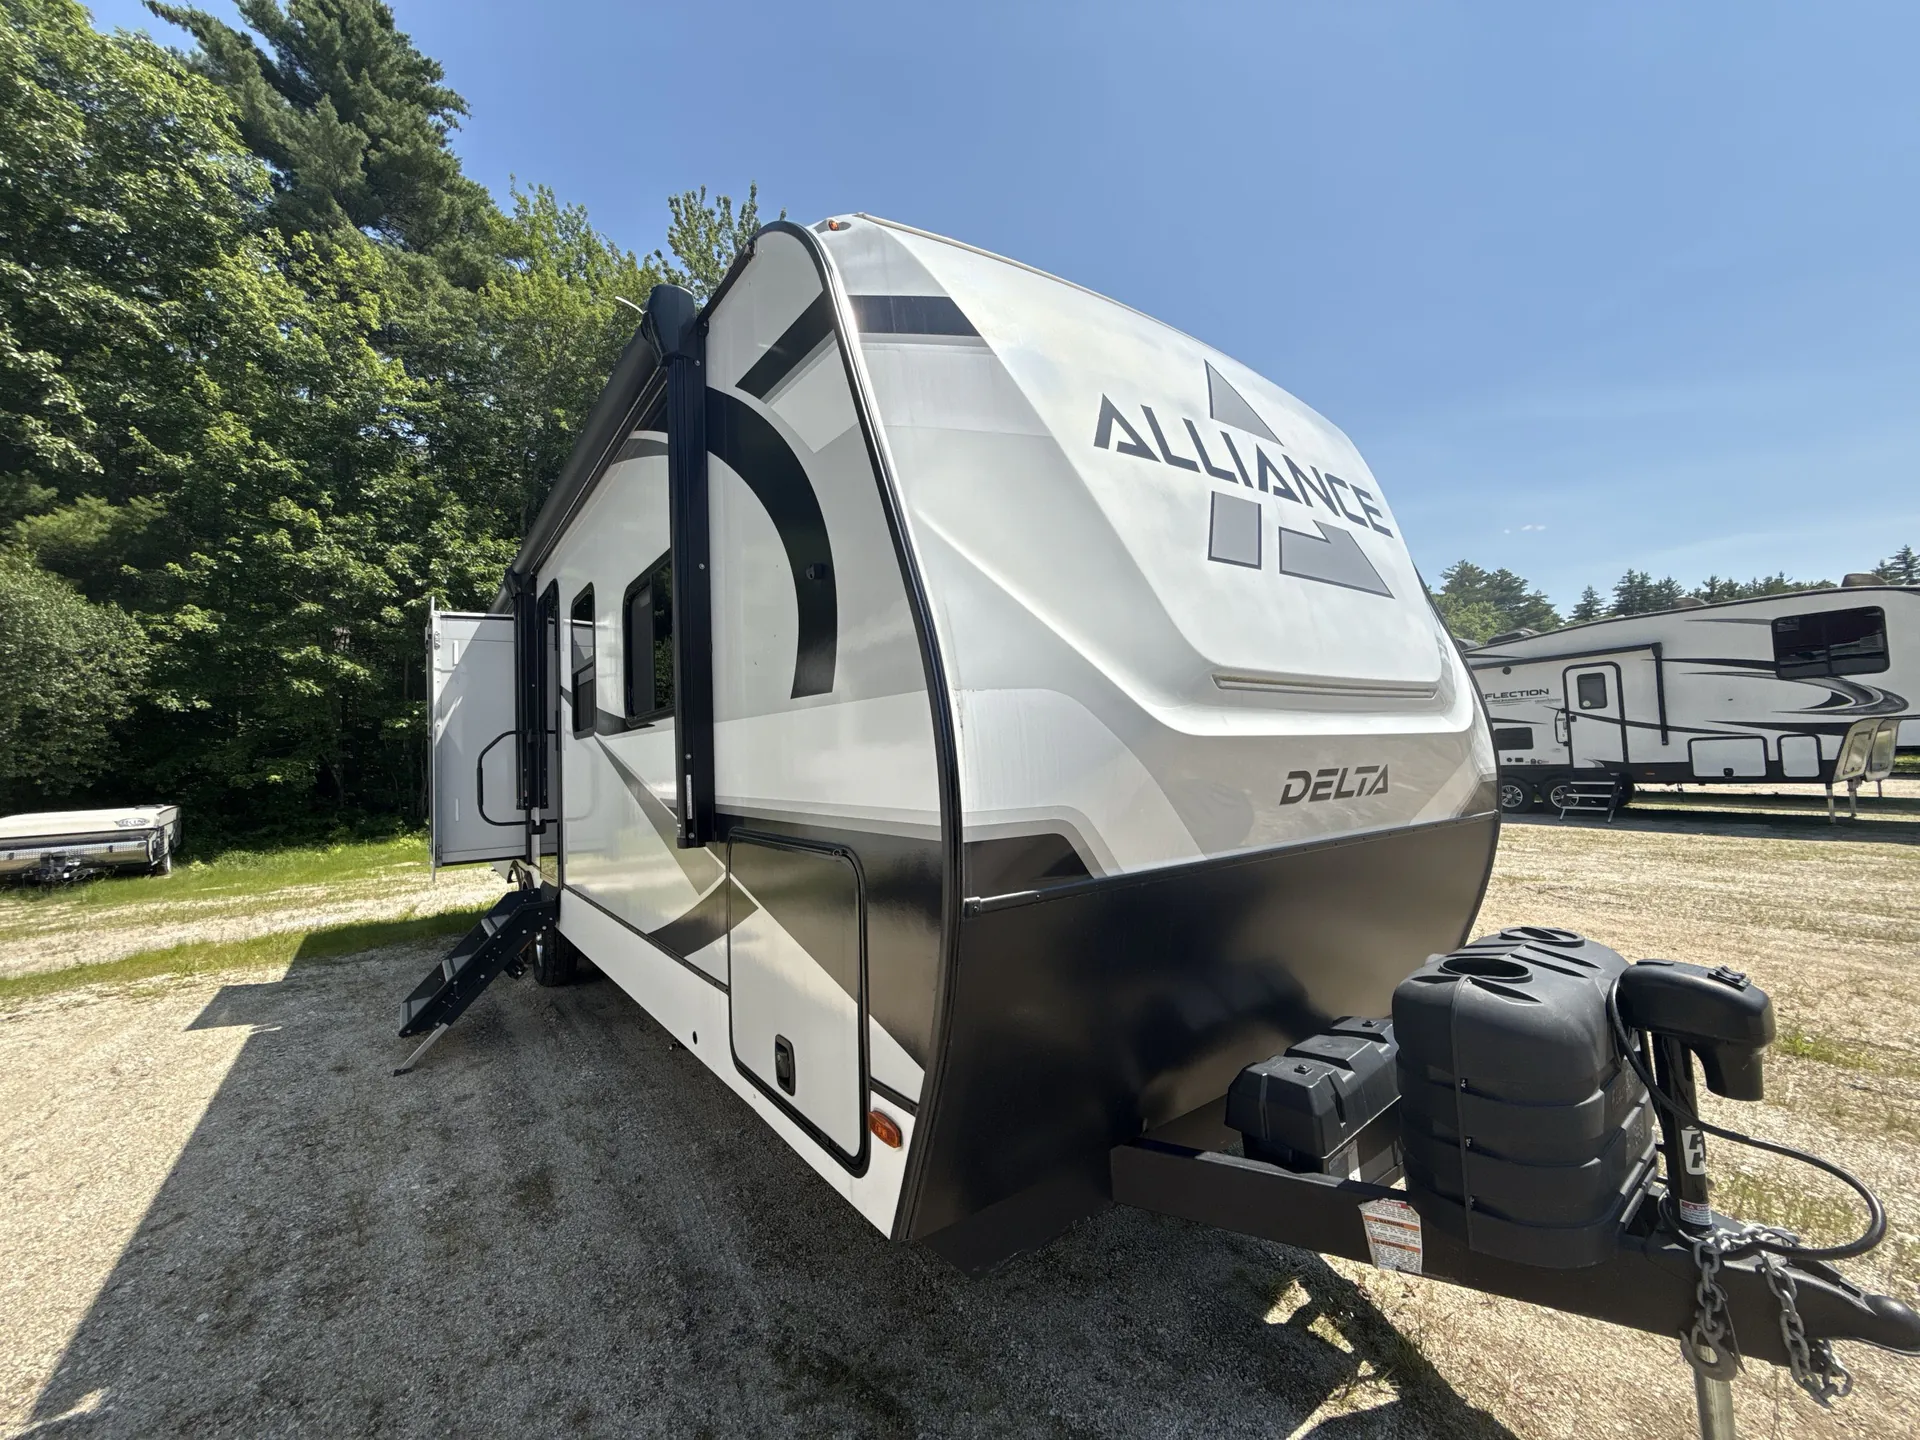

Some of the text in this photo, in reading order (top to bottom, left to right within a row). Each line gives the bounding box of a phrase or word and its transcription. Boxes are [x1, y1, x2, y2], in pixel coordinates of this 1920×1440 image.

[1094, 393, 1394, 539] ALLIANCE
[1482, 688, 1549, 700] FLECTION
[1279, 764, 1388, 806] DELTA
